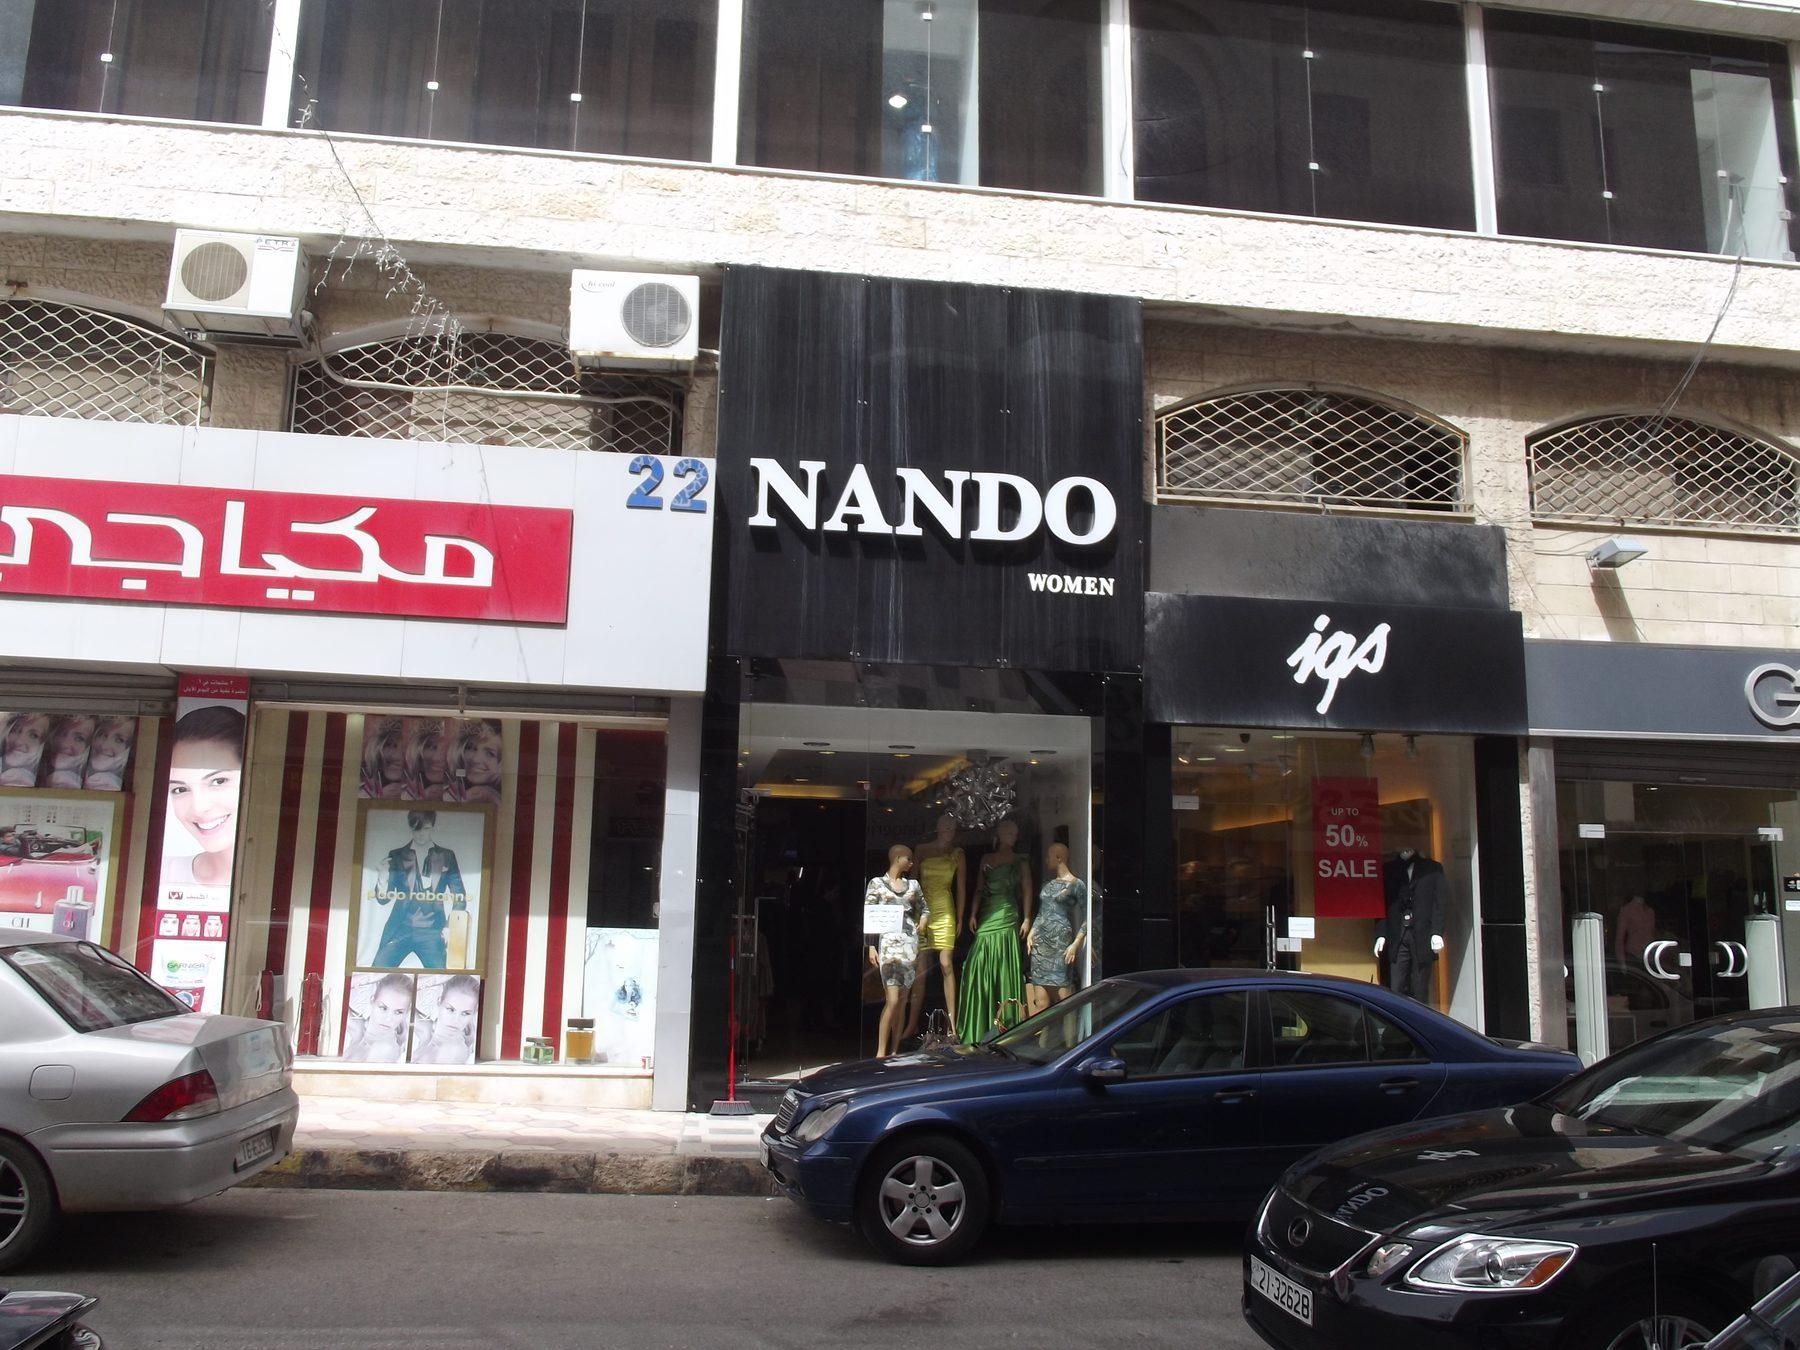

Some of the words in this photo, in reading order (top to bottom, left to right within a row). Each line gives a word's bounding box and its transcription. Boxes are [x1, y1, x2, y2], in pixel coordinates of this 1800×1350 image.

[626, 454, 709, 513] 22
[748, 457, 1117, 546] NANDO
[1027, 572, 1116, 597] WOMEN
[1331, 807, 1344, 817] UP
[1346, 807, 1359, 817] TO
[1325, 824, 1369, 848] 50%
[1318, 859, 1378, 878] SALE
